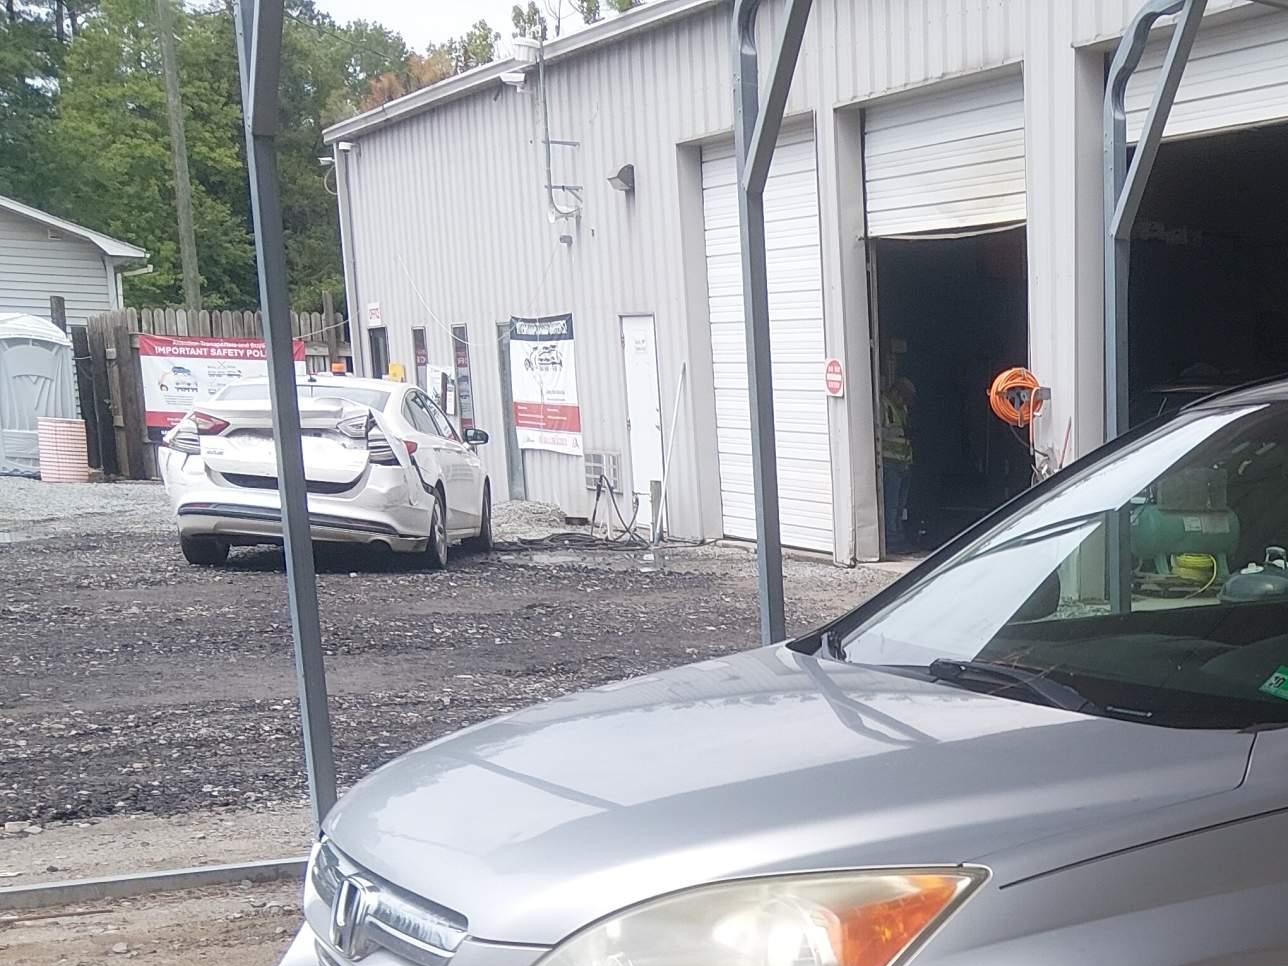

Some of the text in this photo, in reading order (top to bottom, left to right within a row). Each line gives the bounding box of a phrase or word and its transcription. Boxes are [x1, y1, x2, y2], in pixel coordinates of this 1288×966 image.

[154, 345, 266, 358] IMPORTANT SAFETY POL
